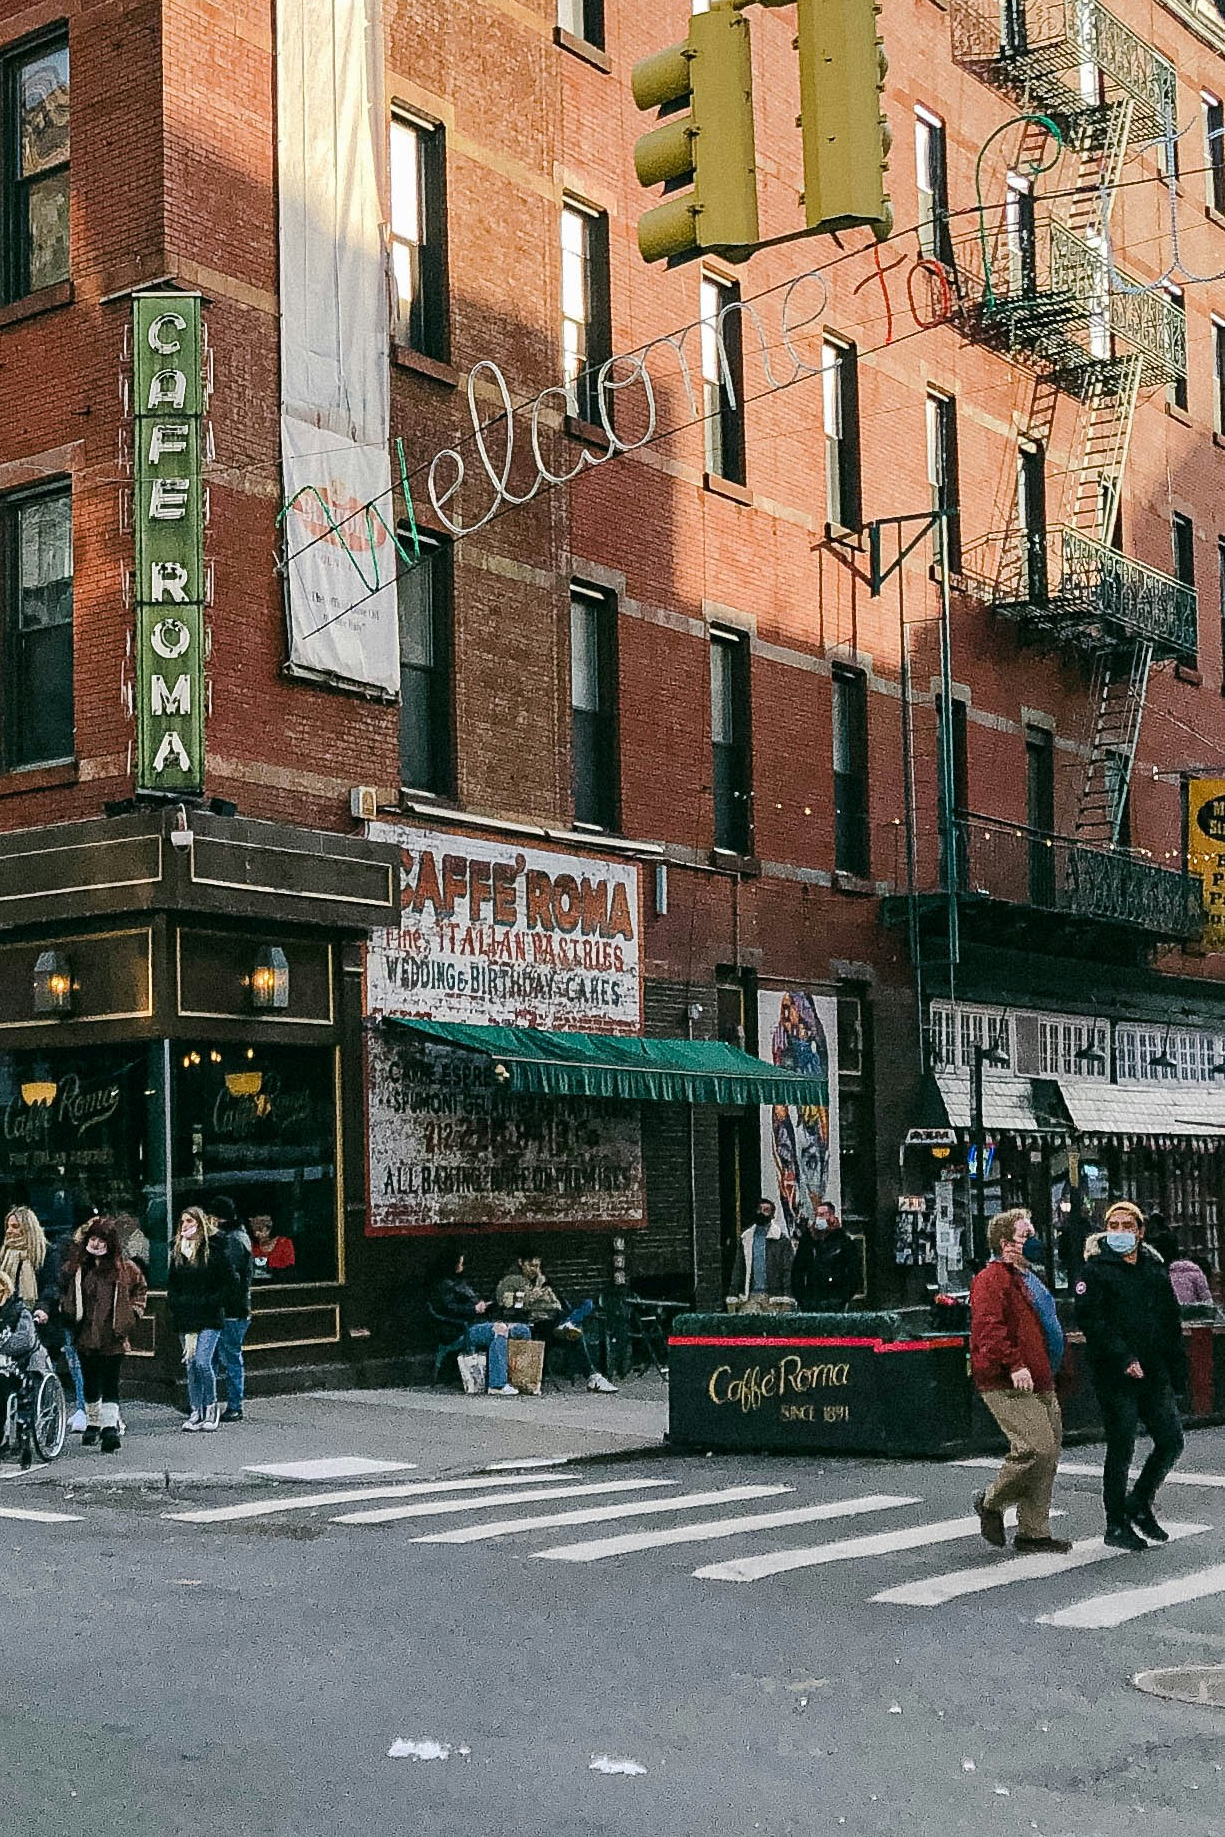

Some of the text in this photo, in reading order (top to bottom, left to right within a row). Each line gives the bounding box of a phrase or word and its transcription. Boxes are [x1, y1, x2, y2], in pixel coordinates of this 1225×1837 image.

[148, 312, 192, 773] CAFE ROMA
[525, 868, 634, 941] ROMA
[531, 930, 624, 973] PASTRIES
[778, 1355, 850, 1396] Roma
[780, 1404, 850, 1423] SINCE 1891
